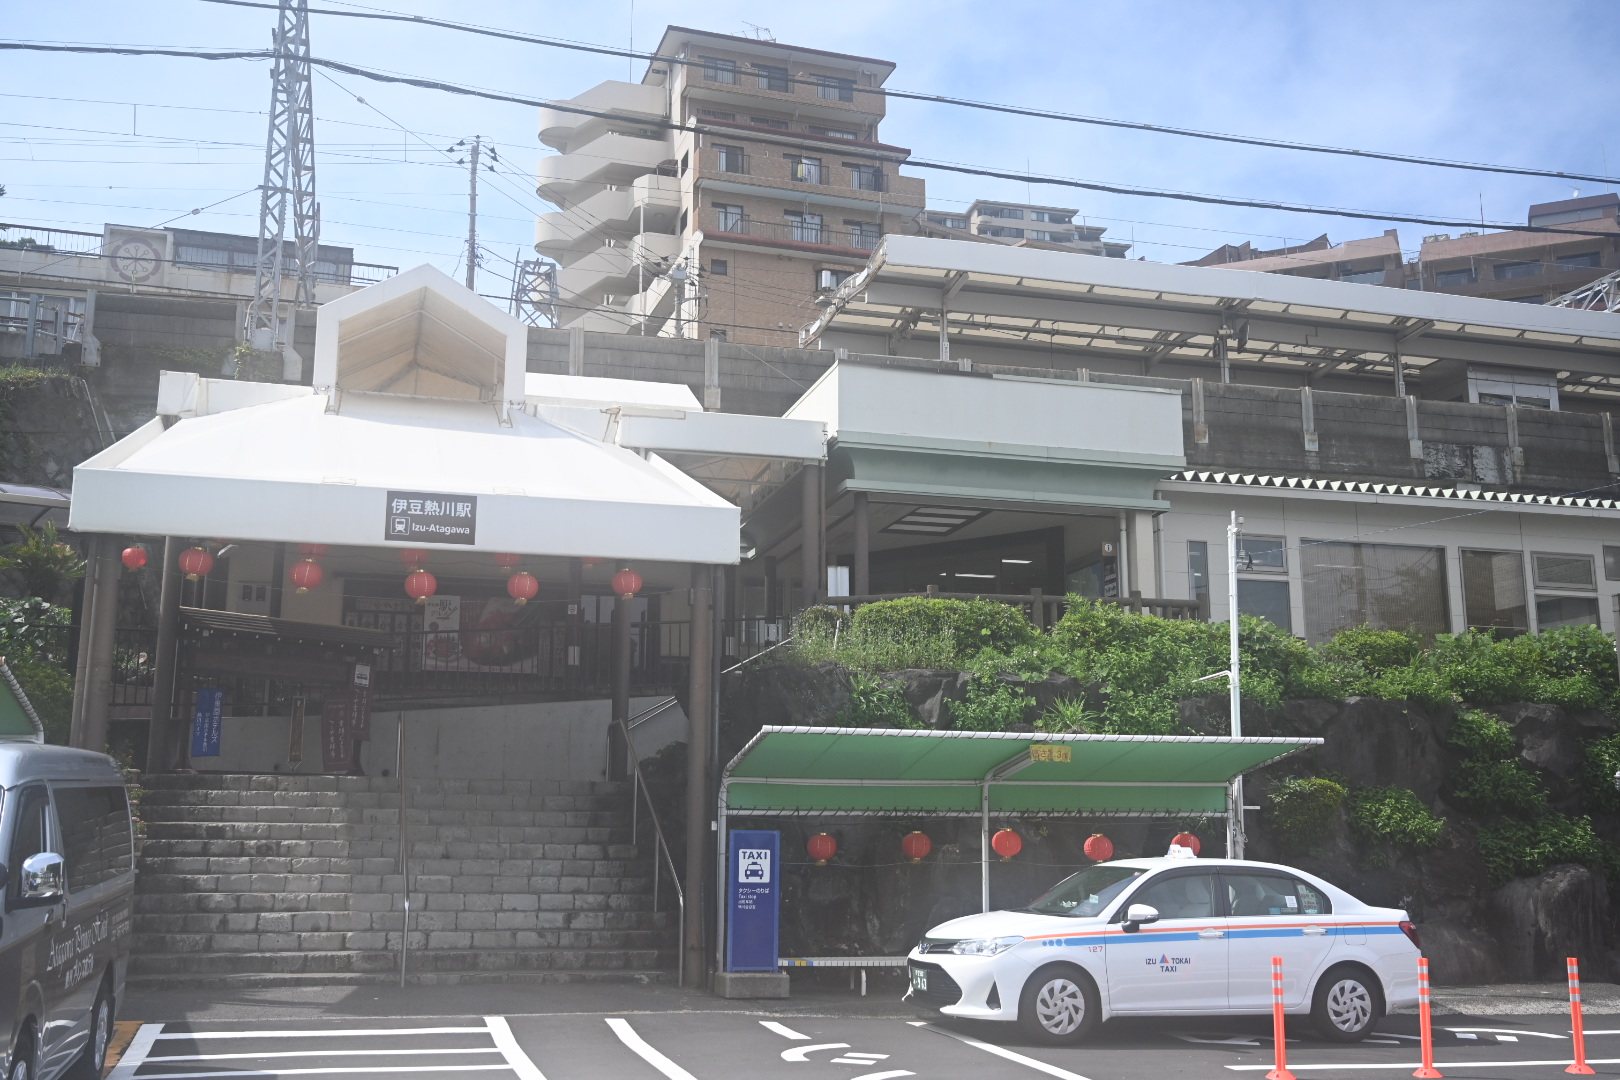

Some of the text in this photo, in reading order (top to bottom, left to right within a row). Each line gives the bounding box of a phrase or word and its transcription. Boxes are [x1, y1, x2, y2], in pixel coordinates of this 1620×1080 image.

[391, 498, 471, 518] 伊豆熱川駅
[412, 522, 470, 535] Izu-Atagawa
[742, 851, 768, 860] TAXI
[1171, 957, 1191, 965] TOKAI
[1160, 965, 1177, 973] TAXI
